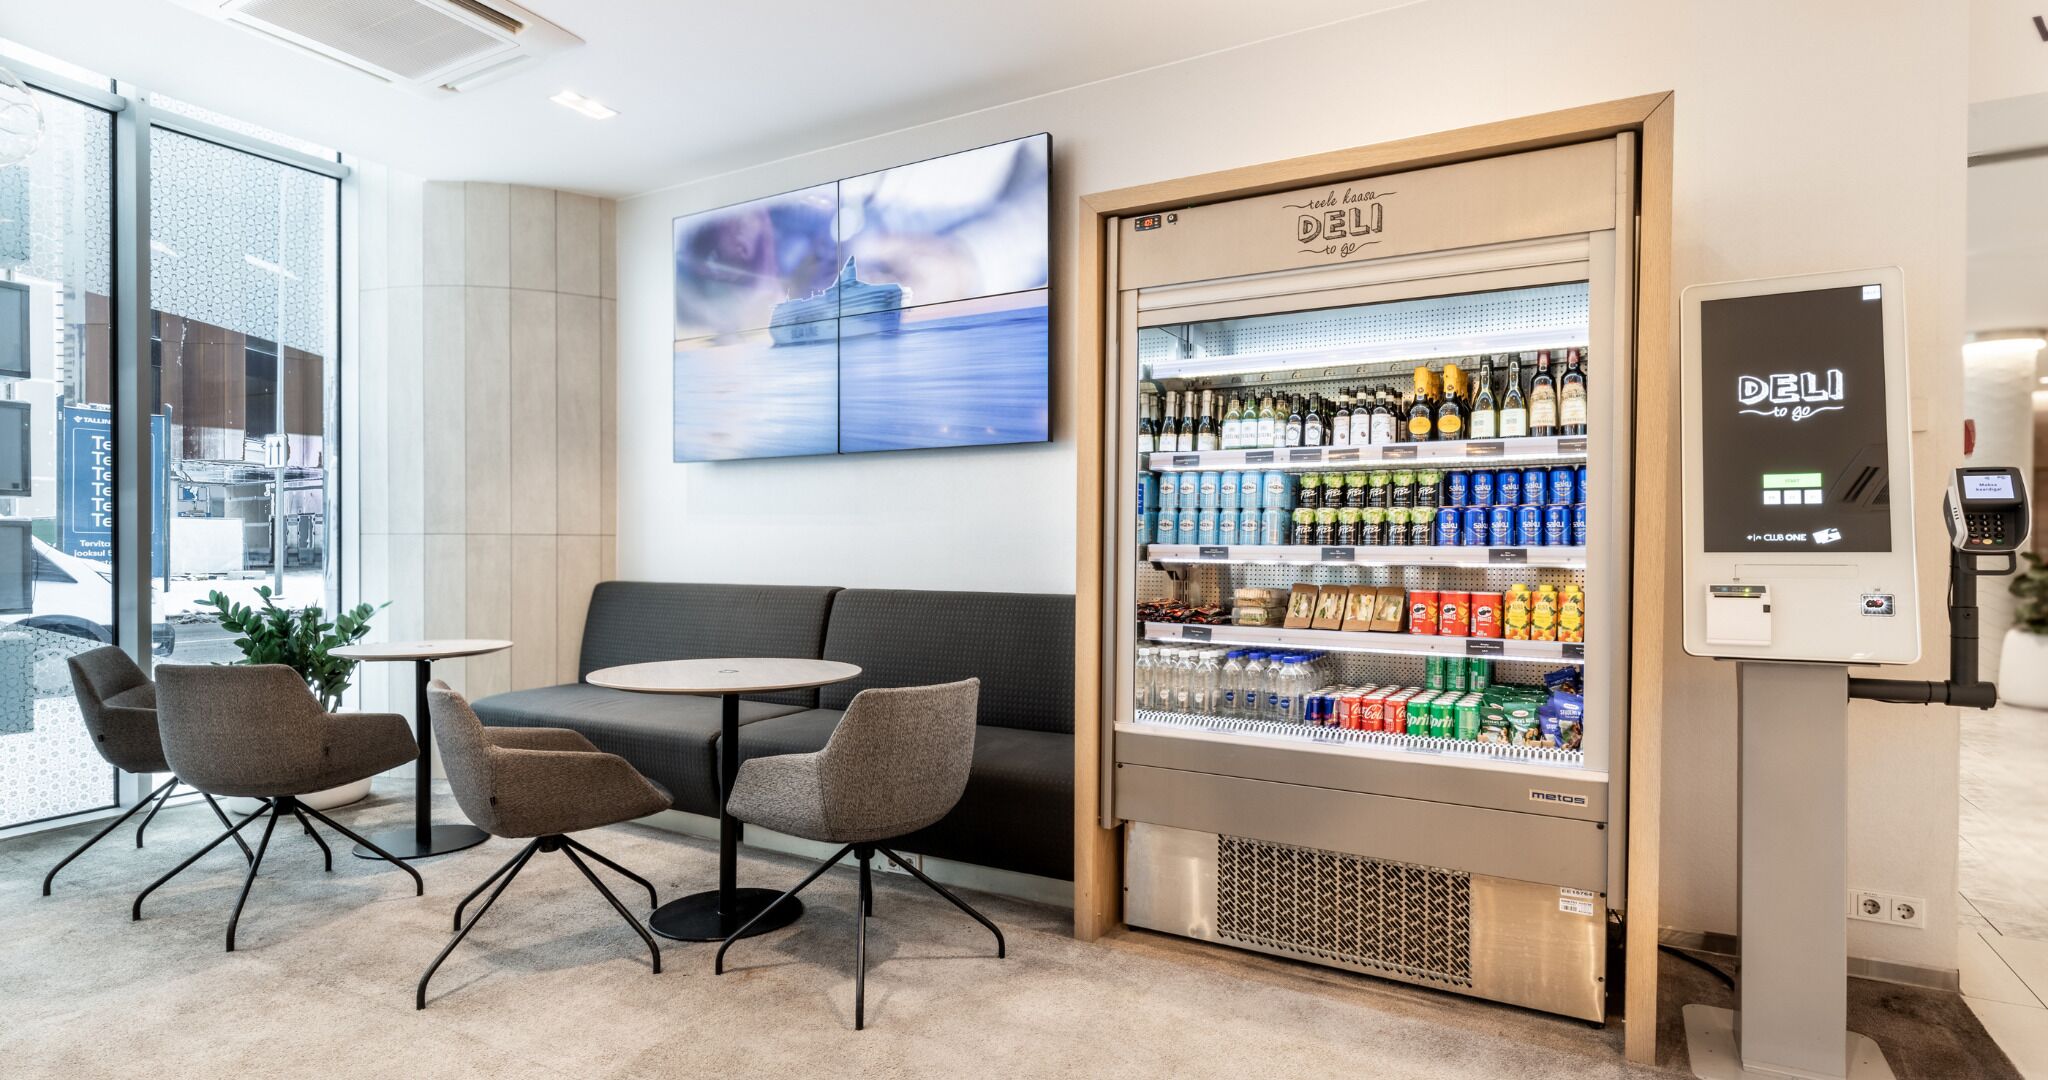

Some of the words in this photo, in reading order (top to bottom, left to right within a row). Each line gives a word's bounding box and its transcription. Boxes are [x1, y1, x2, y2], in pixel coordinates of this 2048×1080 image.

[1308, 190, 1338, 209] teele
[1342, 187, 1375, 204] kaasa
[1297, 202, 1383, 244] DELI
[1325, 244, 1337, 255] to
[1340, 242, 1356, 258] go
[1738, 368, 1844, 405] DELI
[1773, 406, 1788, 418] to
[1791, 405, 1811, 421] go
[1763, 533, 1784, 542] CLUB
[1785, 533, 1807, 542] ONE
[1532, 791, 1585, 804] metos
